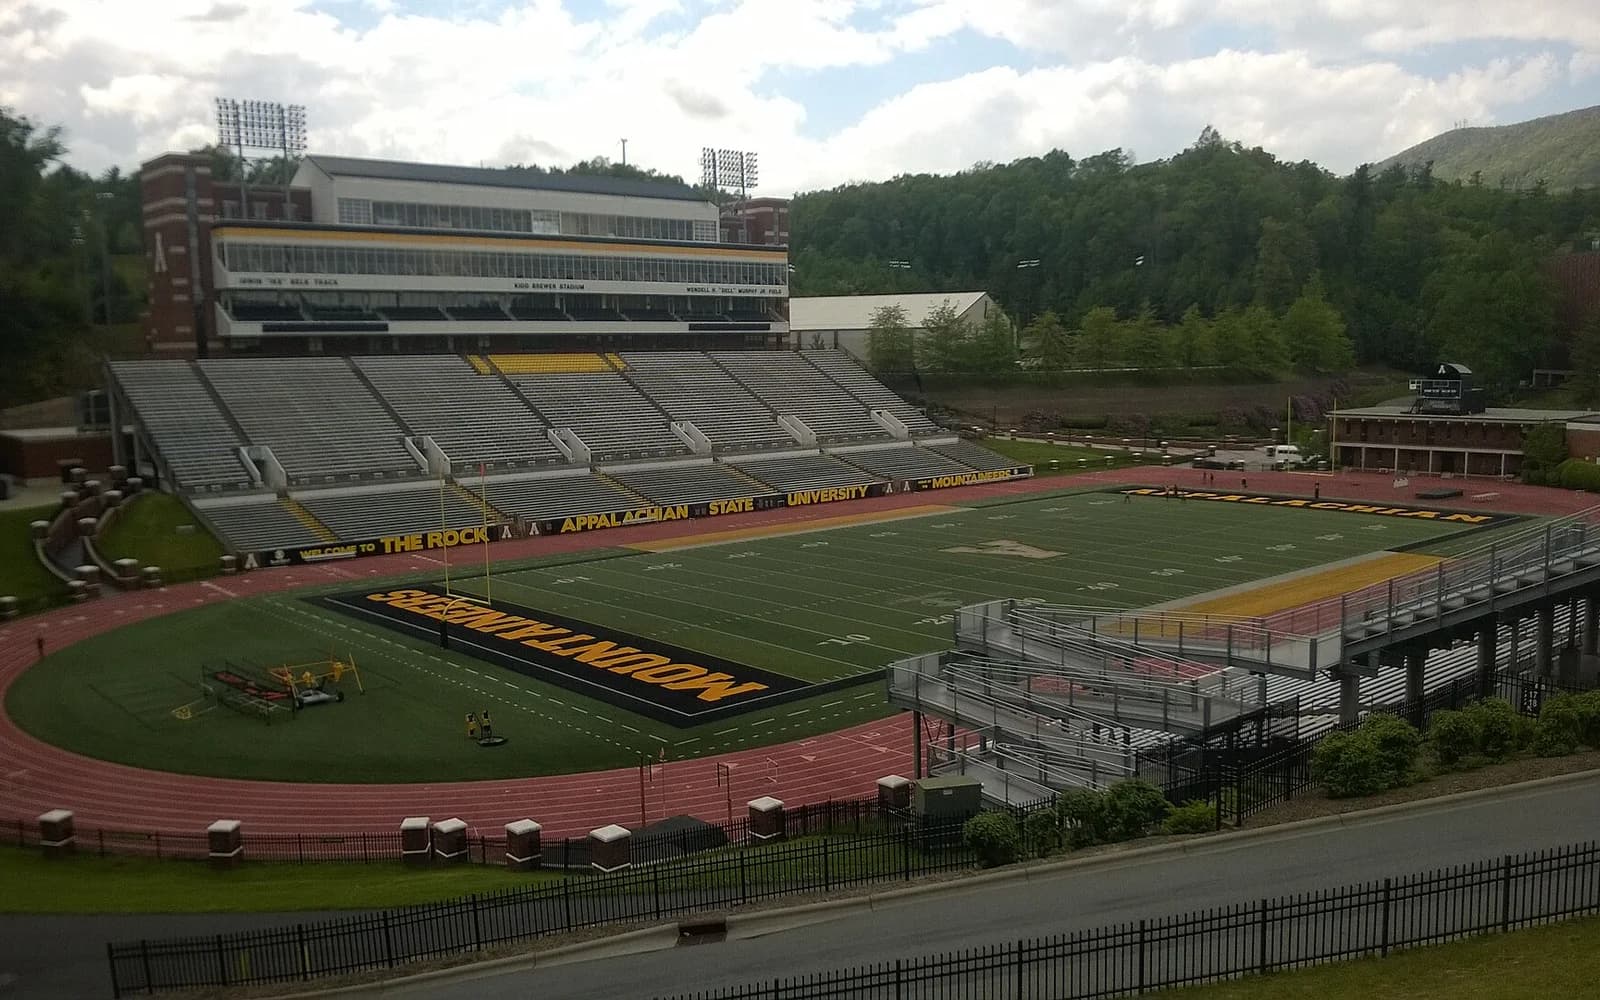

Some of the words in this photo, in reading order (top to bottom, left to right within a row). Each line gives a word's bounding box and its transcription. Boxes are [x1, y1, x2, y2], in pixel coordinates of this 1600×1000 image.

[932, 469, 1012, 489] MOUNTAINEERS
[560, 504, 689, 533] APPALACHIAN
[709, 497, 754, 516] STATE
[787, 485, 869, 506] UNIVERSITY
[300, 544, 357, 558] WELCOME
[359, 543, 375, 552] TO
[380, 533, 424, 554] THE
[427, 527, 489, 550] ROCK
[366, 589, 769, 702] MOUNTAINEERS
[817, 633, 871, 647] 10
